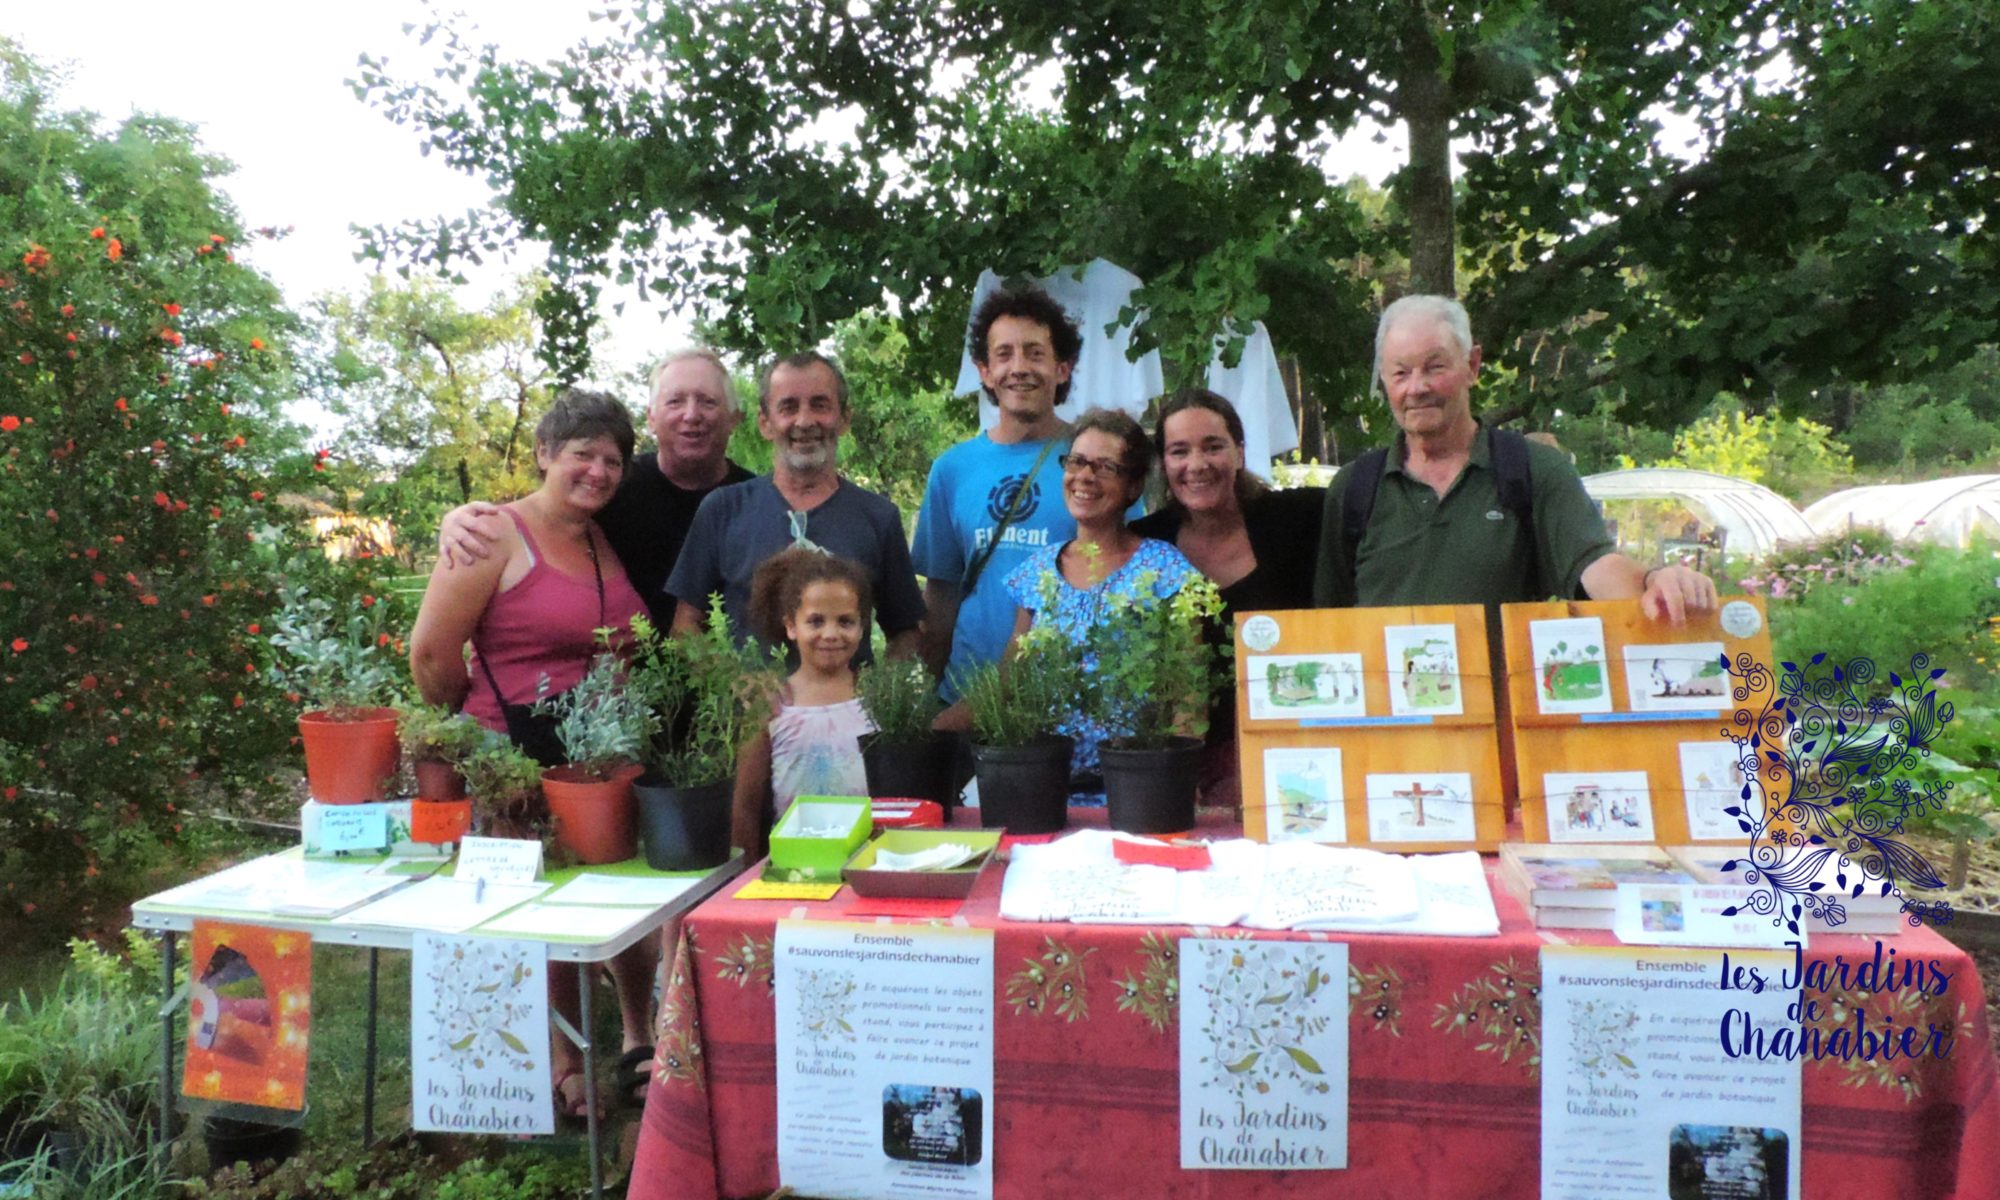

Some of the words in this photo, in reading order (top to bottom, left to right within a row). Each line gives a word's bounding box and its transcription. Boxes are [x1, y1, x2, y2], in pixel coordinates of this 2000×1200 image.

[975, 525, 1049, 549] Elment
[854, 933, 914, 947] Ensemble
[788, 946, 981, 966] #sauvonslesjardinsdechanabier
[1636, 960, 1707, 973] Ensemble
[864, 982, 876, 992] En
[881, 985, 929, 996] acquérant
[934, 986, 948, 995] les
[952, 988, 983, 998] objets
[862, 1001, 931, 1012] promotionnels
[936, 1004, 951, 1013] sur
[957, 1006, 984, 1015] notre
[898, 1020, 920, 1028] vous
[924, 1021, 974, 1032] participez
[1650, 1013, 1664, 1023] En
[866, 1033, 888, 1043] faire
[893, 1037, 930, 1046] avancer
[949, 1040, 979, 1050] projet
[812, 1044, 856, 1061] Jardins
[875, 1050, 885, 1060] de
[890, 1052, 918, 1062] jardin
[923, 1056, 971, 1066] botanique
[1690, 1054, 1715, 1062] vous
[796, 1060, 858, 1078] Chanabier
[1651, 1069, 1677, 1080] faire
[1683, 1073, 1727, 1082] avancer
[1732, 1075, 1745, 1083] ce
[1751, 1075, 1786, 1086] projet
[456, 1074, 535, 1102] Jardins
[1586, 1081, 1639, 1100] Jardins
[1660, 1088, 1675, 1098] de
[1680, 1089, 1713, 1100] jardin
[1718, 1092, 1777, 1104] botanique
[429, 1103, 538, 1130] Chanabier
[1199, 1106, 1224, 1129] Les
[1233, 1101, 1329, 1131] Jardins
[1567, 1100, 1638, 1118] Chanabier
[1237, 1128, 1254, 1145] de
[1199, 1136, 1329, 1166] Chanabier
